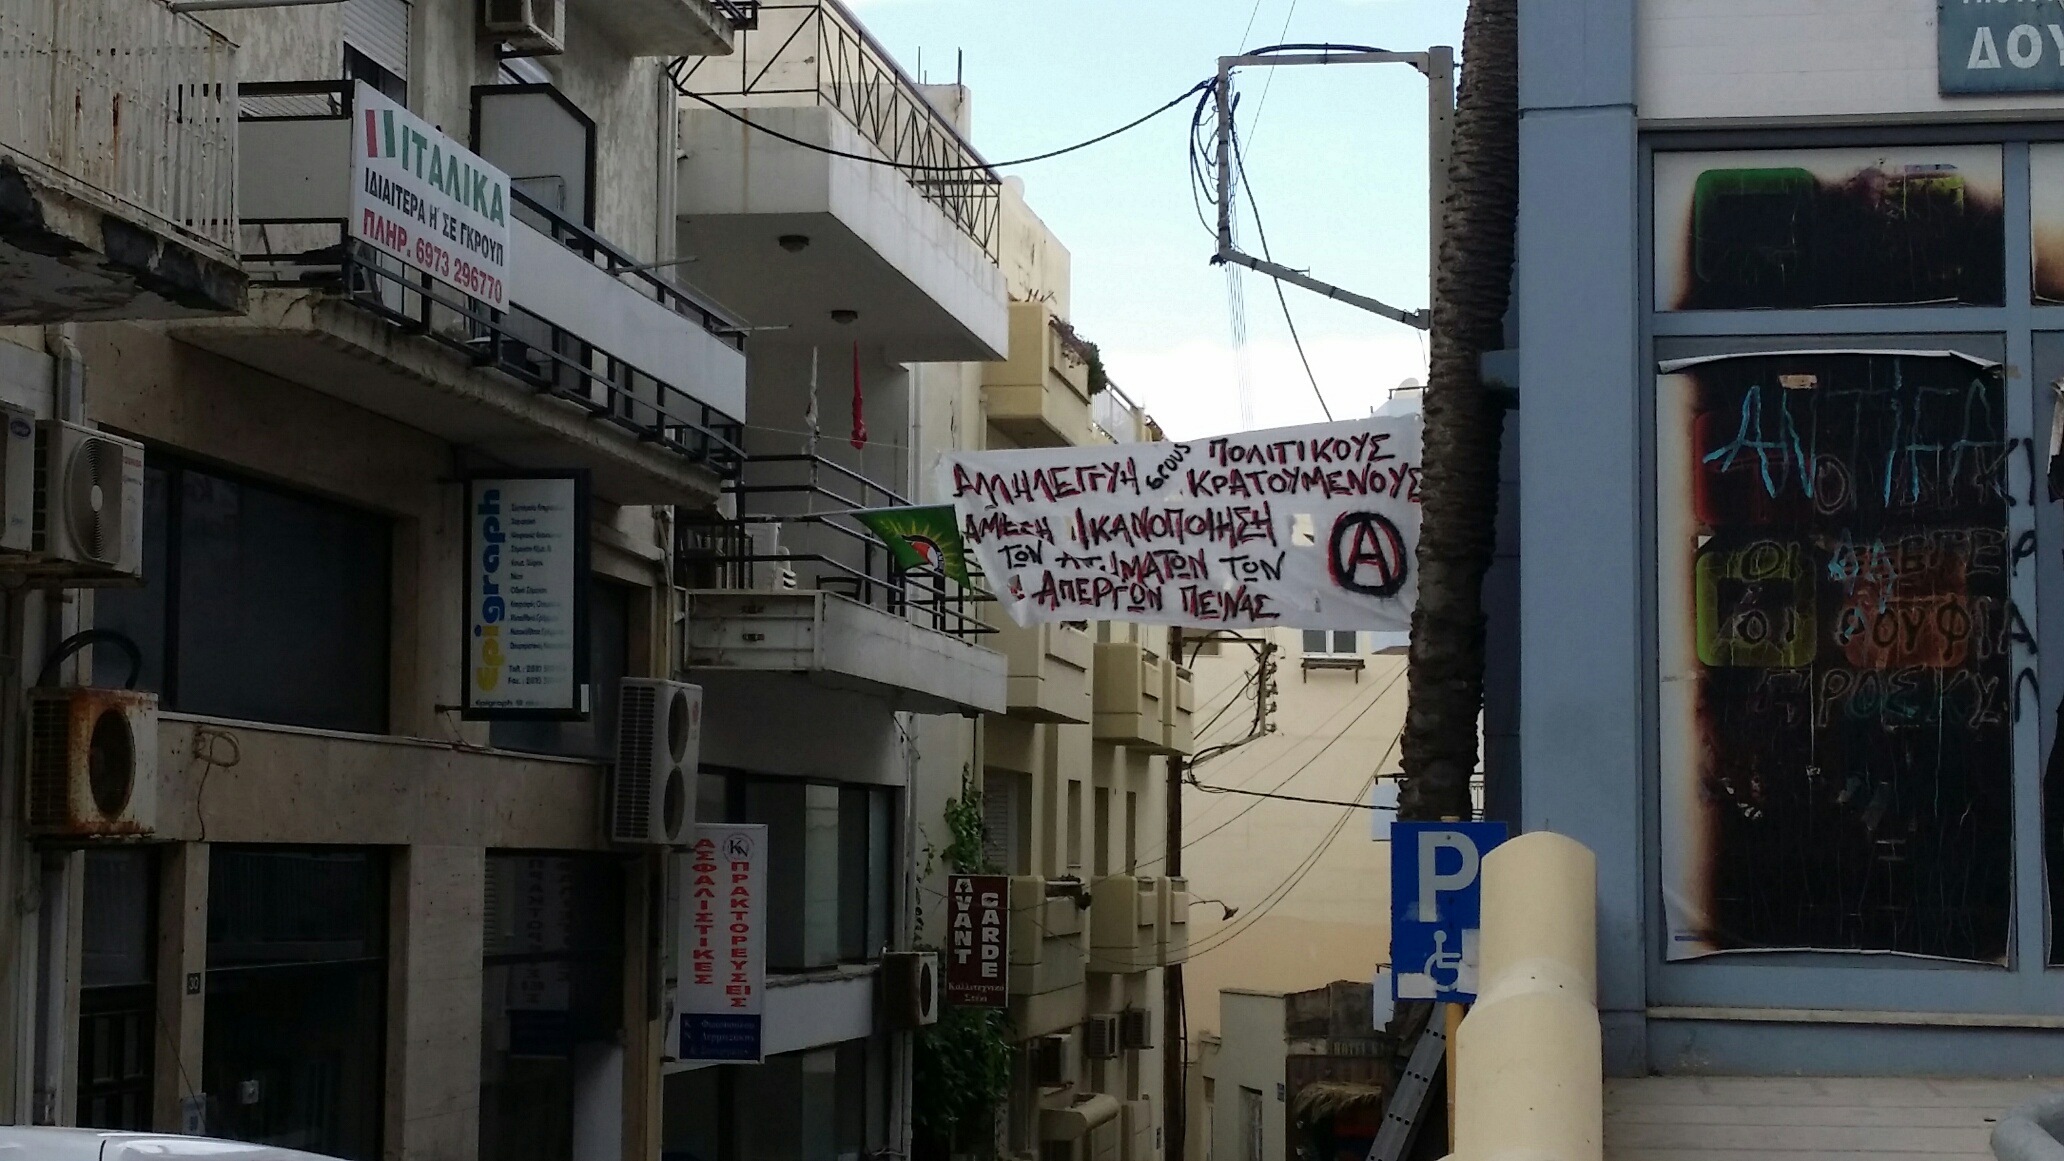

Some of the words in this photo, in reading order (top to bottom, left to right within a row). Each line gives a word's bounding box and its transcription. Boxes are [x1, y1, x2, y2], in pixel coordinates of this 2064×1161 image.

[365, 167, 426, 224] ΙΔΙΑΙΤΕΡΑ
[443, 212, 457, 242] ΣΕ
[459, 222, 504, 267] ΓΚΡΟΥΠ
[402, 125, 505, 227] ΙΤΑΛΙΚΑ
[363, 208, 411, 258] ΠΛΗΡ.
[416, 237, 450, 278] 6973
[454, 258, 503, 304] 296770
[1187, 462, 1422, 502] ΚΡΑΤΟΥΜΕΝΟΥΣ
[1210, 432, 1396, 467] ΠΟΛΙΤΙΚΟΥΣ
[1074, 500, 1278, 550] ΙΚΑΝΟΠΟΙΗΣΗ
[692, 838, 717, 985] ΑΣΦΑΛΙΣΤΙΚΕΣ
[953, 878, 973, 965] AVANT
[1418, 831, 1479, 922] P
[726, 861, 750, 1008] ΠΡΑΚΤΟΡΕΥΣΕΙΣ
